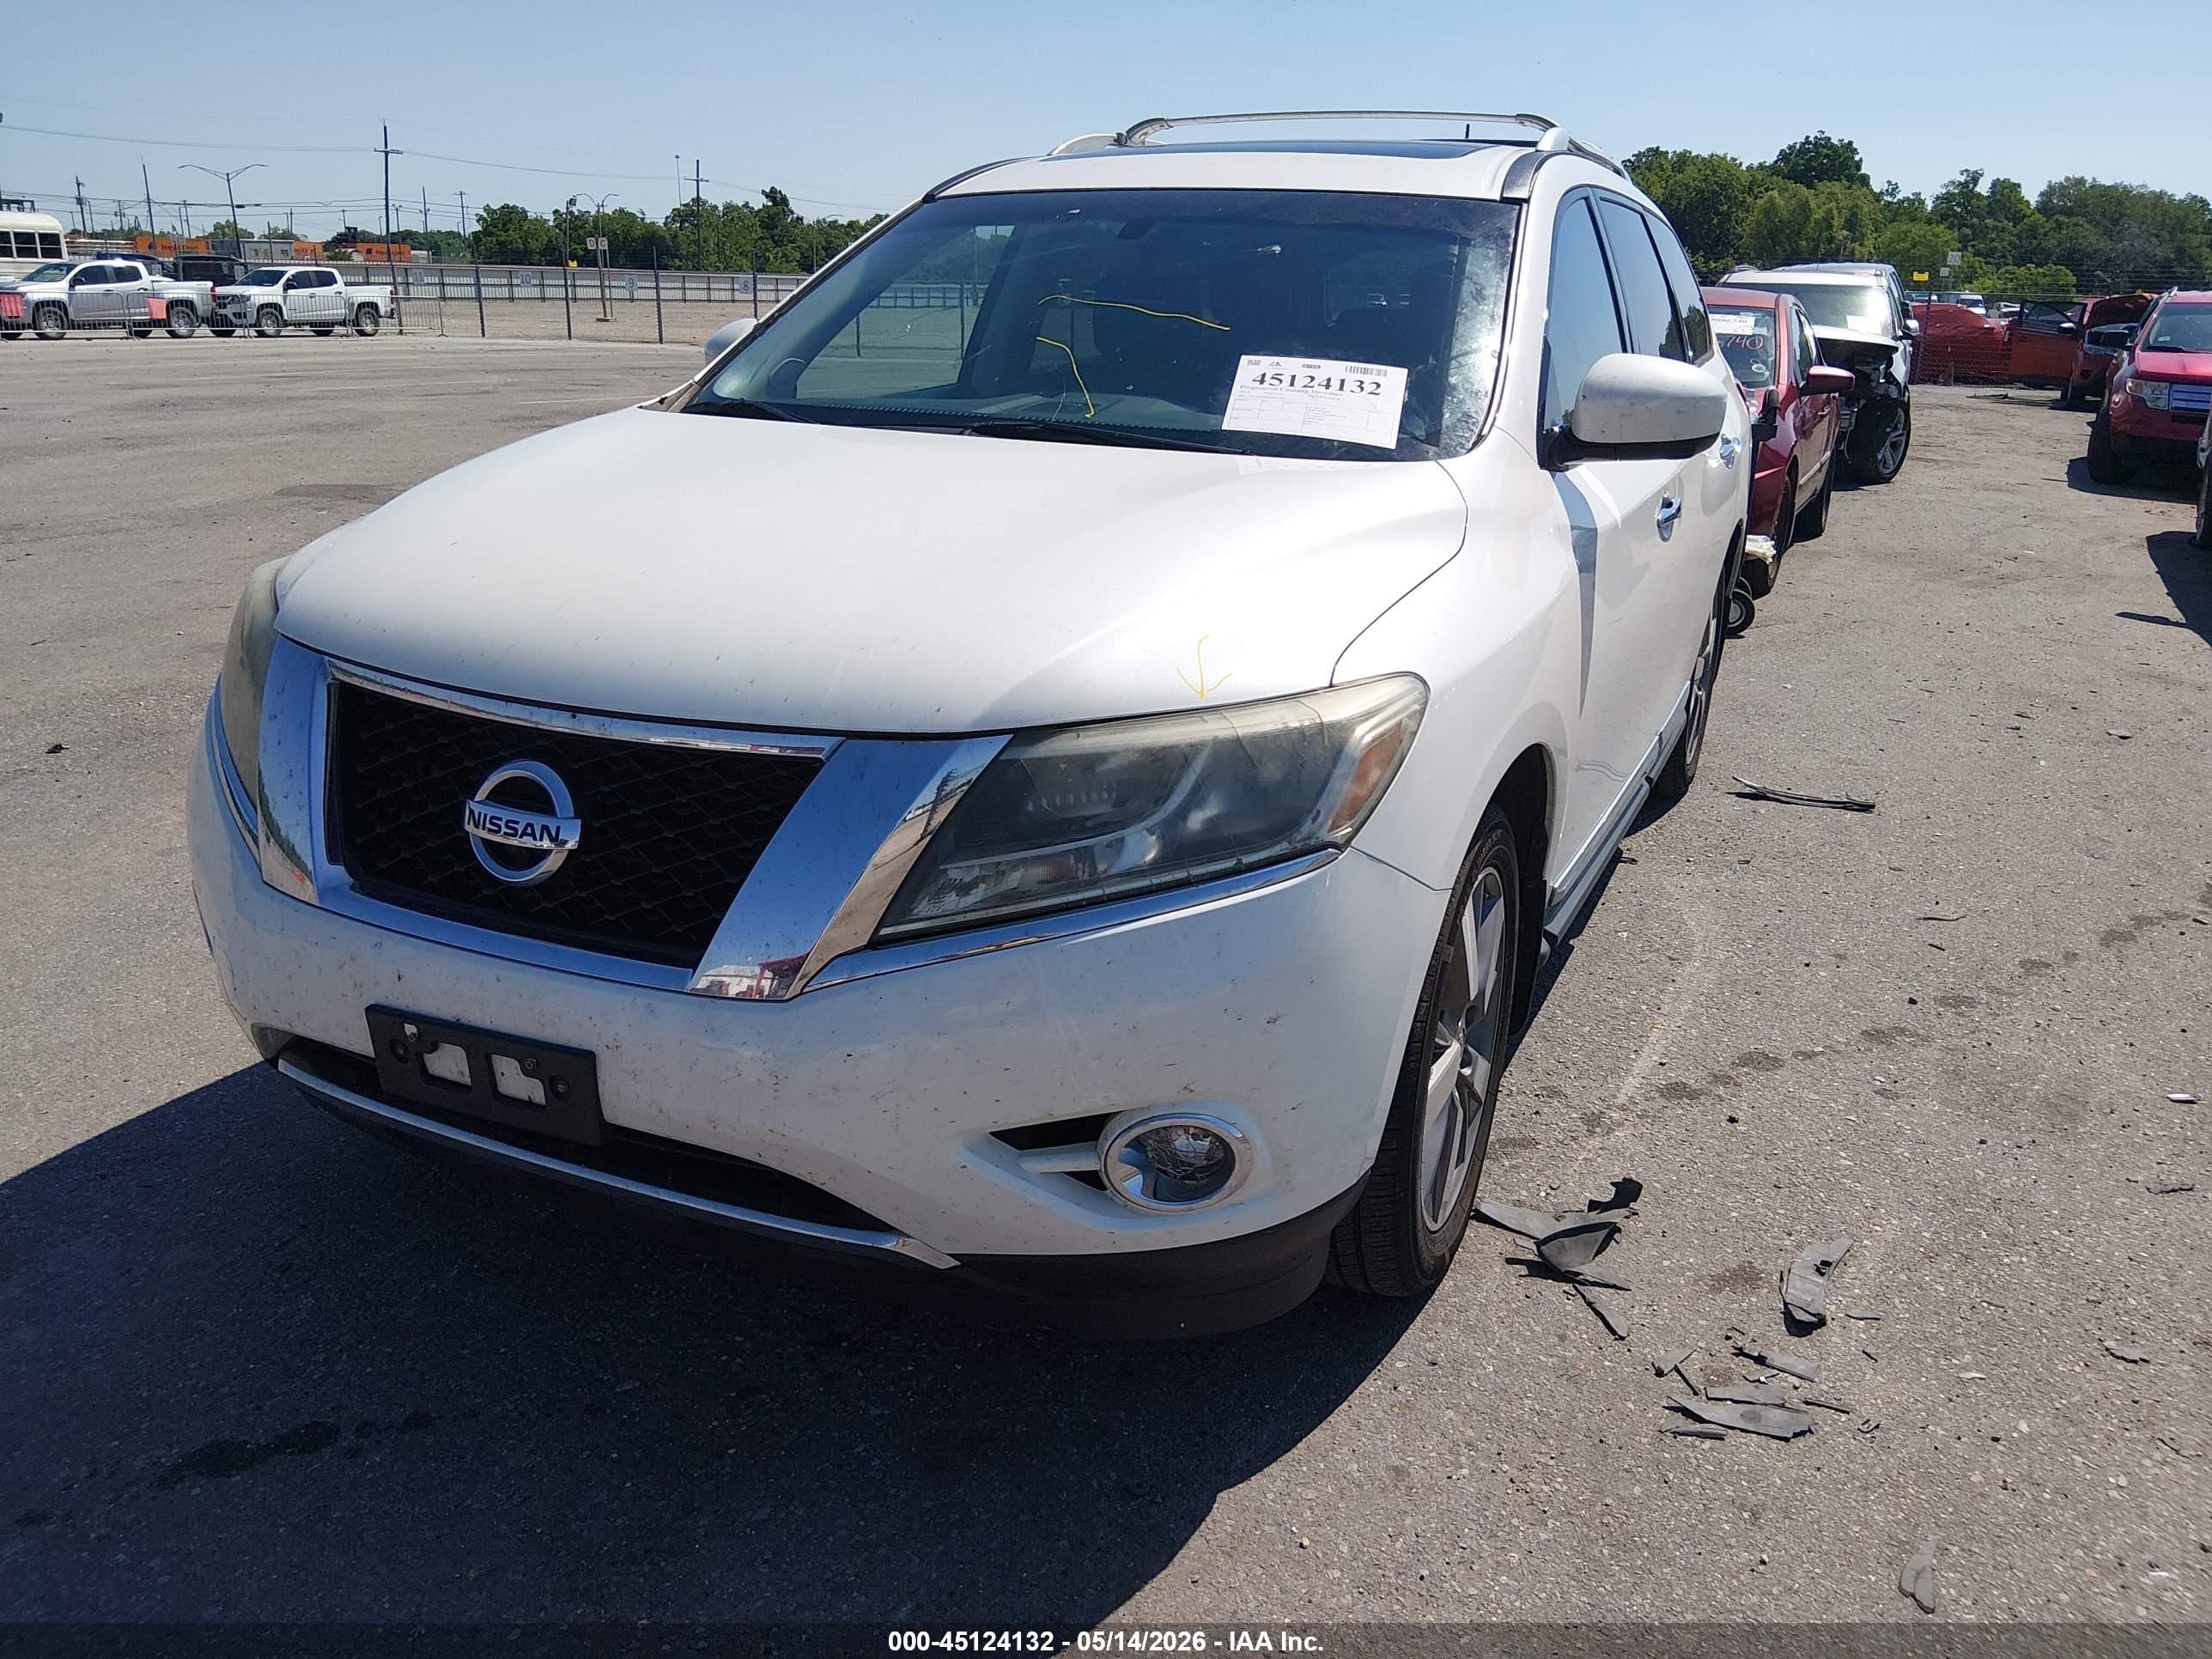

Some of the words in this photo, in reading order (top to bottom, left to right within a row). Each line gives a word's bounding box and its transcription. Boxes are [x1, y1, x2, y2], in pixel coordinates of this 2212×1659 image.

[588, 239, 595, 248] D
[599, 239, 606, 248] C
[1949, 253, 1960, 263] 20
[628, 277, 635, 288] 9
[743, 280, 750, 292] 8
[1251, 372, 1382, 396] 45124132
[467, 808, 561, 843] NISSAN
